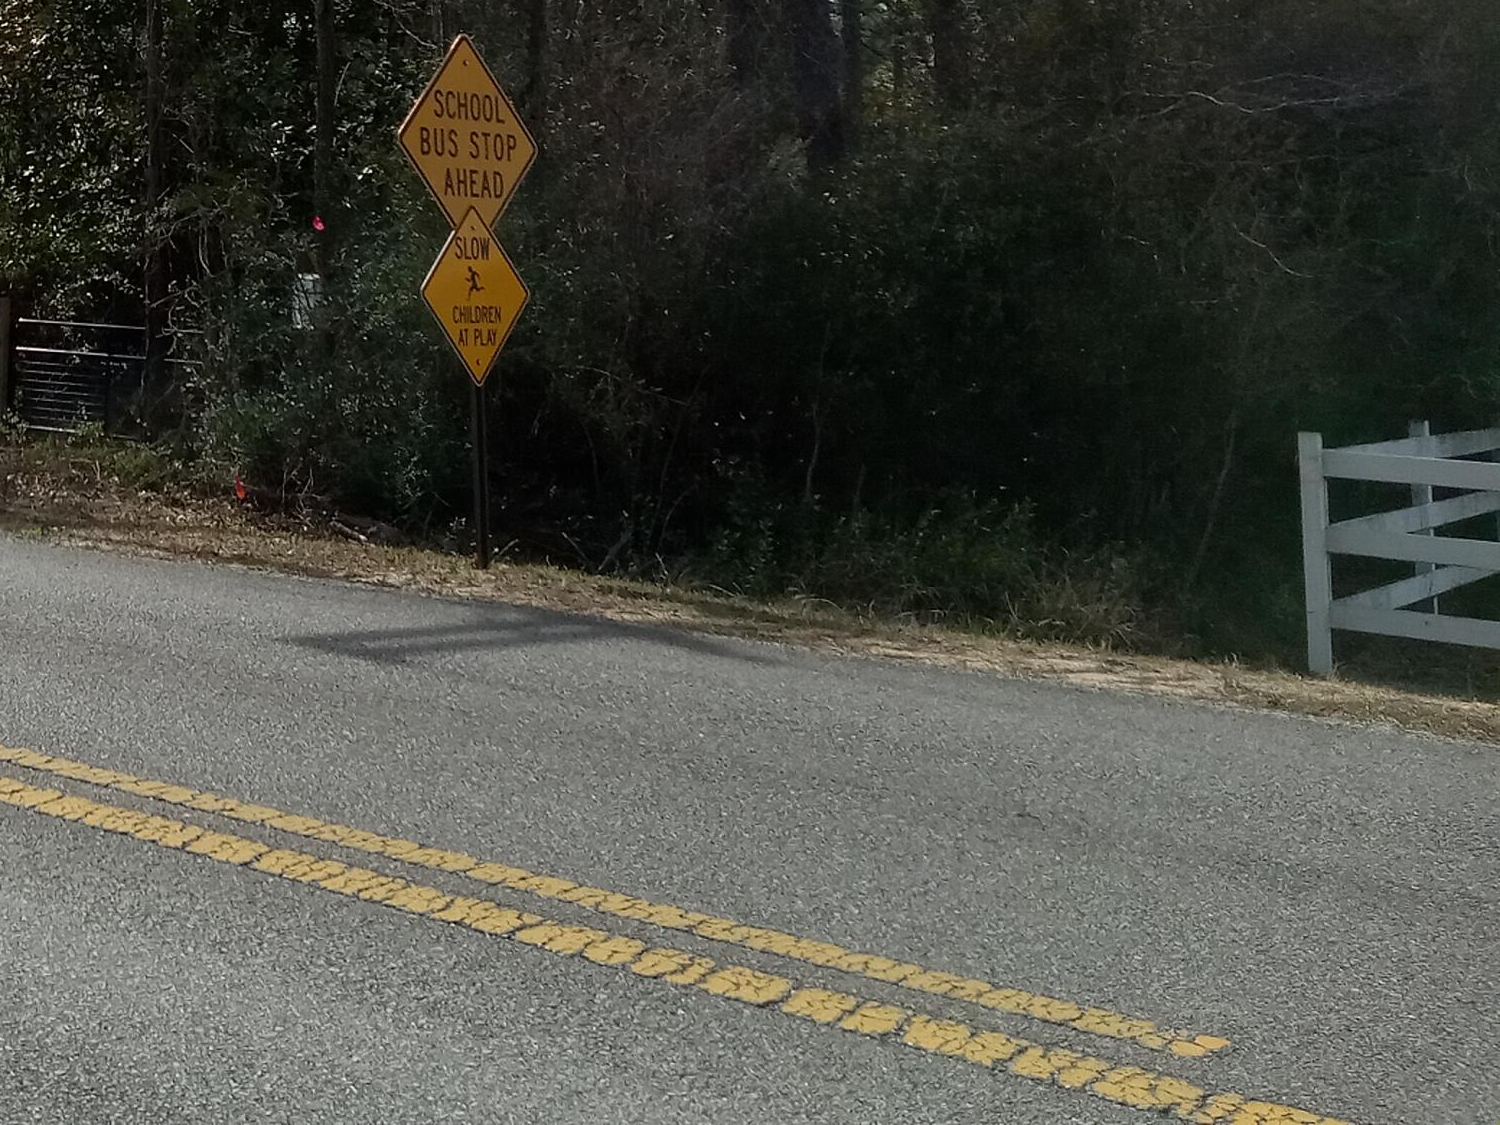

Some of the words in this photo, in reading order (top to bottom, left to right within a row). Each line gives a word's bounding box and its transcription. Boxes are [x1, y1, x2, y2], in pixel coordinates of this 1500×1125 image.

[433, 90, 505, 124] SCHOOL
[420, 126, 458, 157] BUS
[469, 131, 517, 162] STOP
[444, 168, 504, 199] AHEAD
[454, 236, 491, 260] SLOW
[452, 306, 501, 324] CHILDREN
[458, 328, 469, 347] AT
[474, 328, 497, 347] PLAY
